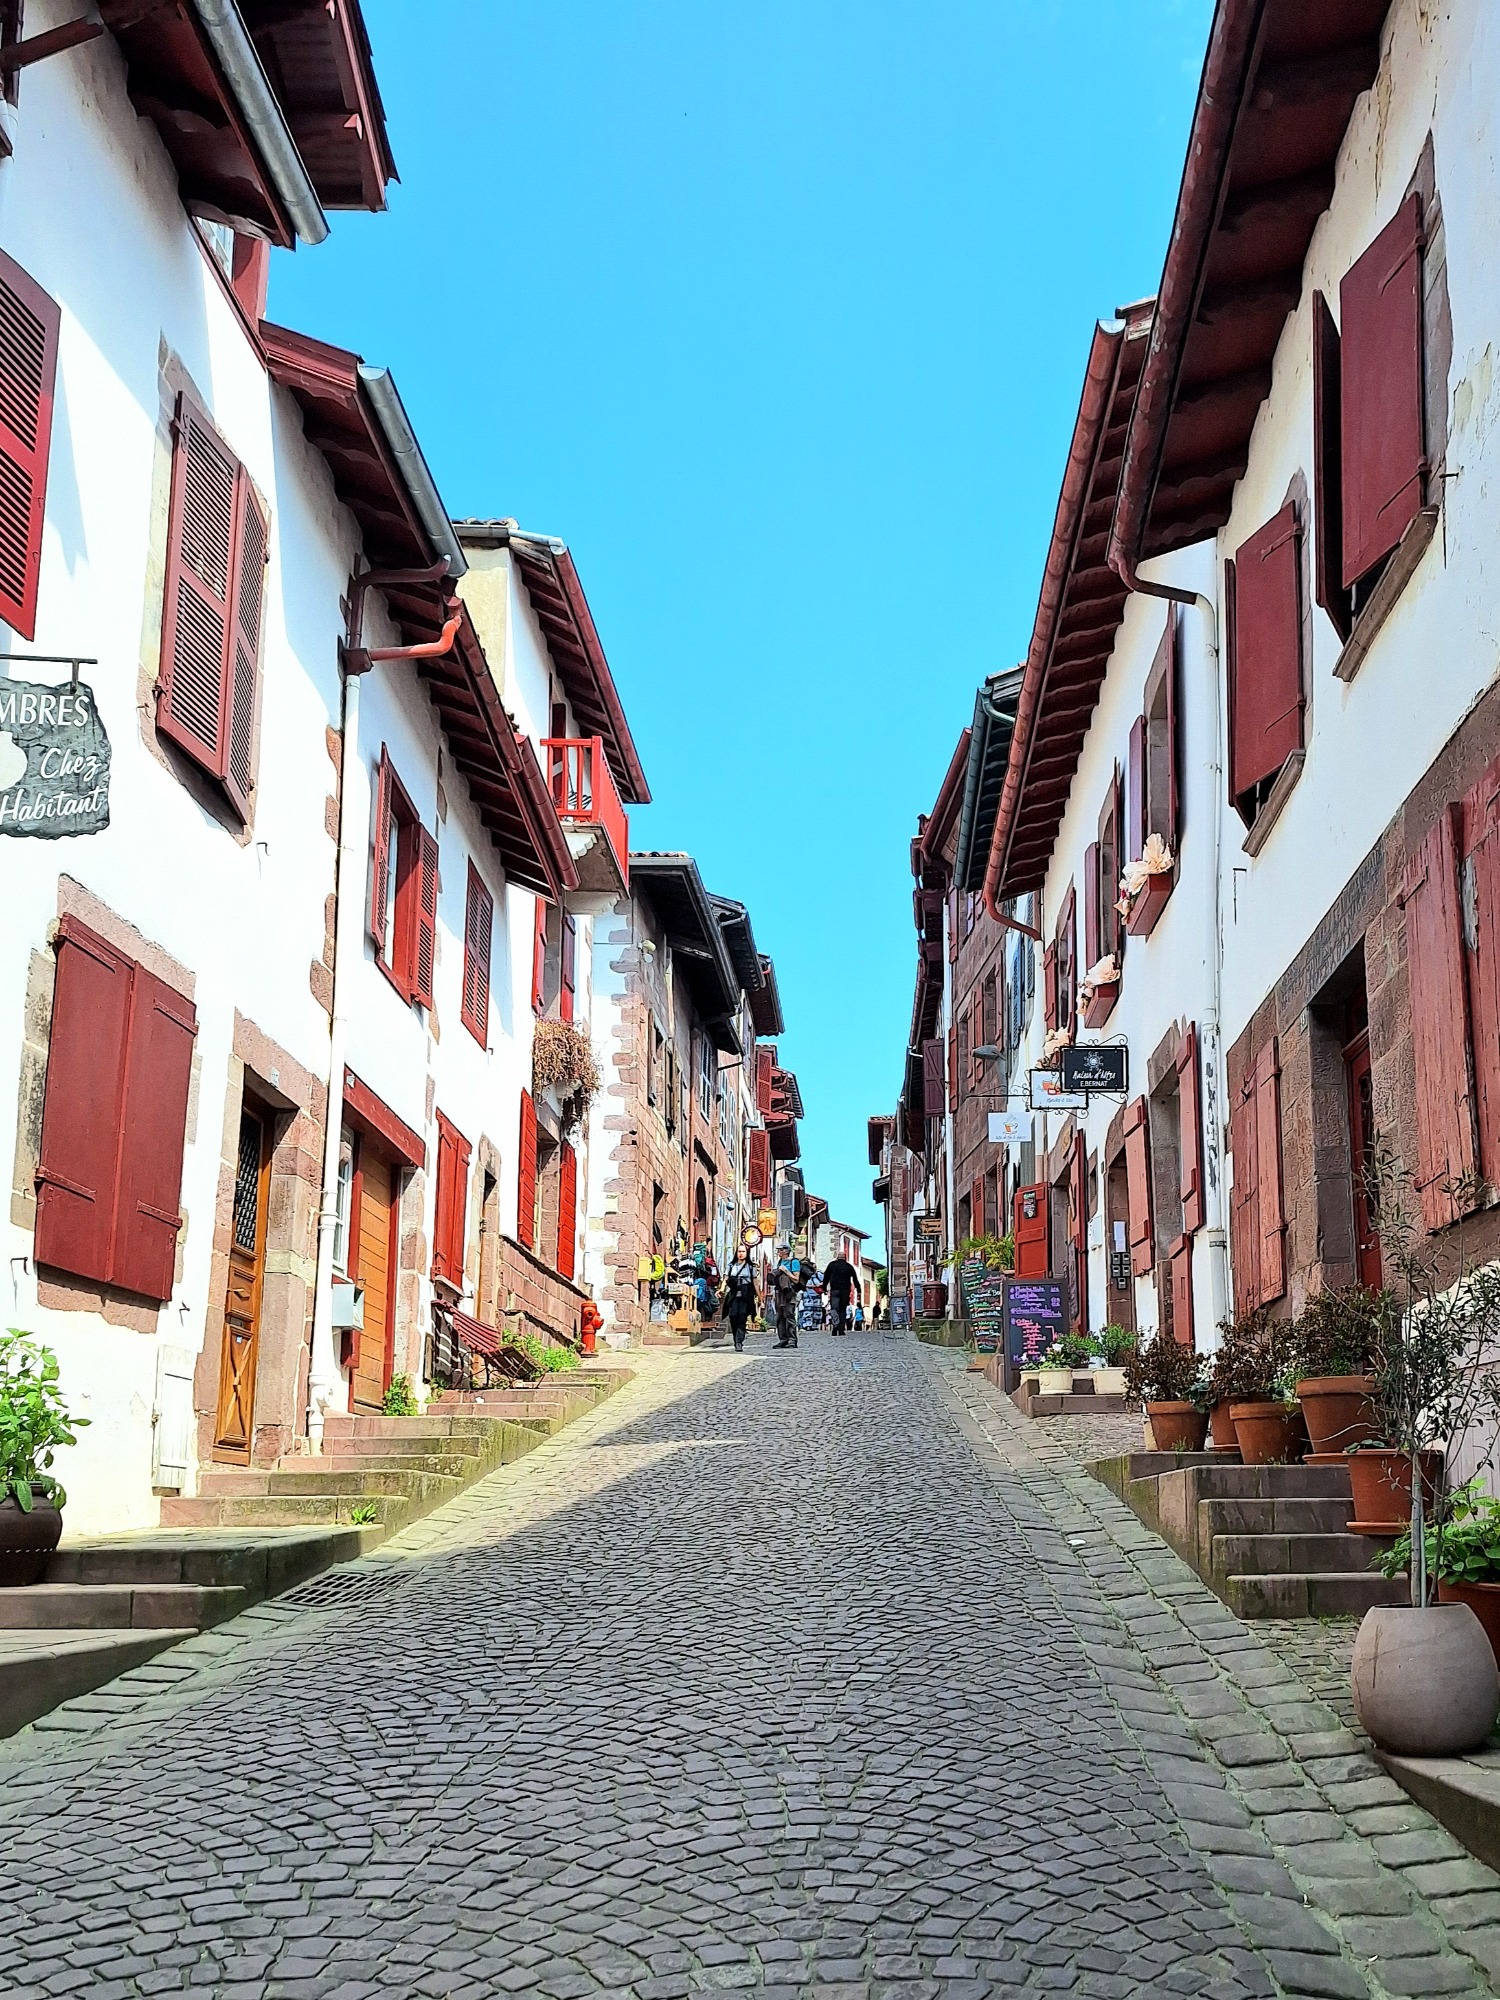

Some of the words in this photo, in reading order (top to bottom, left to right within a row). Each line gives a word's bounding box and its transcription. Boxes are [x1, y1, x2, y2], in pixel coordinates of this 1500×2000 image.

[0, 693, 90, 727] MBRES
[40, 747, 102, 782] Chez
[0, 786, 107, 825] Habitant
